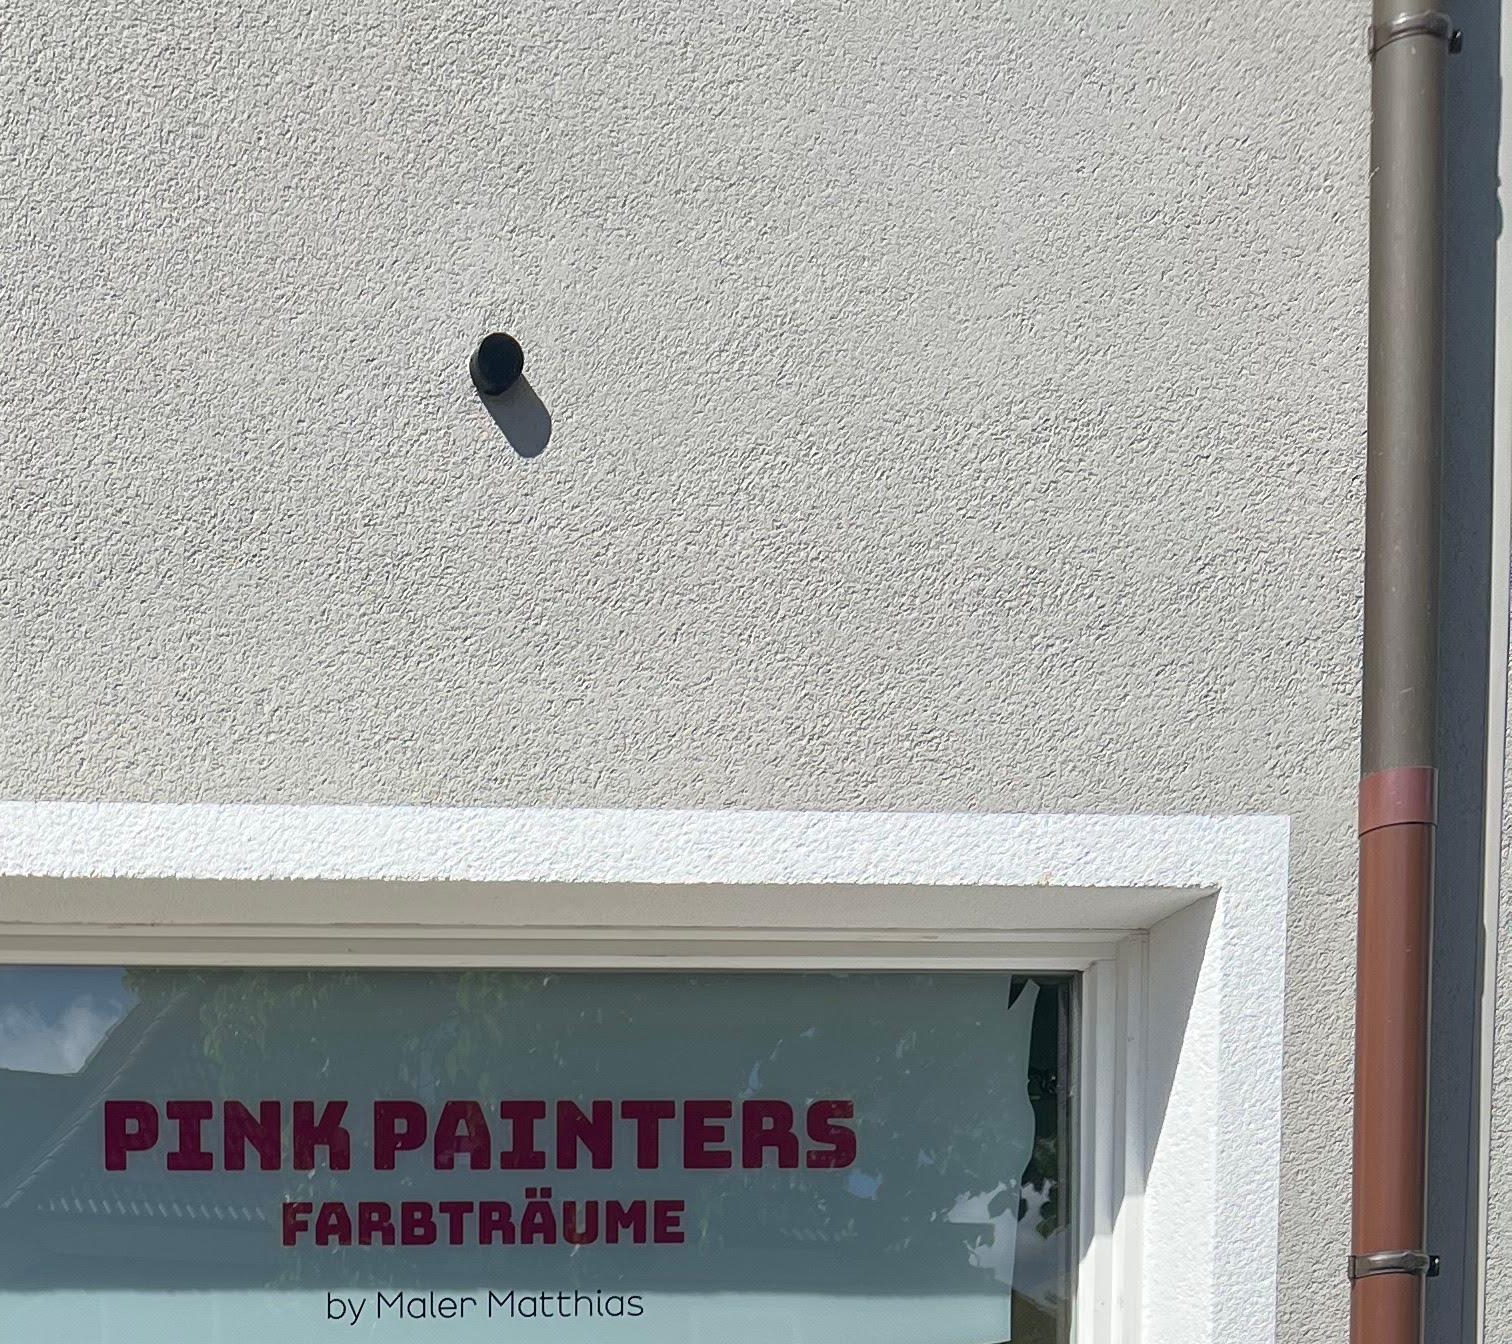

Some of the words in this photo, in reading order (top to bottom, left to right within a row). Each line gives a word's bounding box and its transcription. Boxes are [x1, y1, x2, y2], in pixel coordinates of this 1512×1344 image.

[105, 1100, 350, 1171] PINK
[374, 1100, 857, 1170] PAINTERS
[282, 1187, 686, 1246] FARBTRÄUME
[327, 1291, 367, 1325] by
[376, 1290, 477, 1319] Maler
[488, 1288, 645, 1318] Matthias
